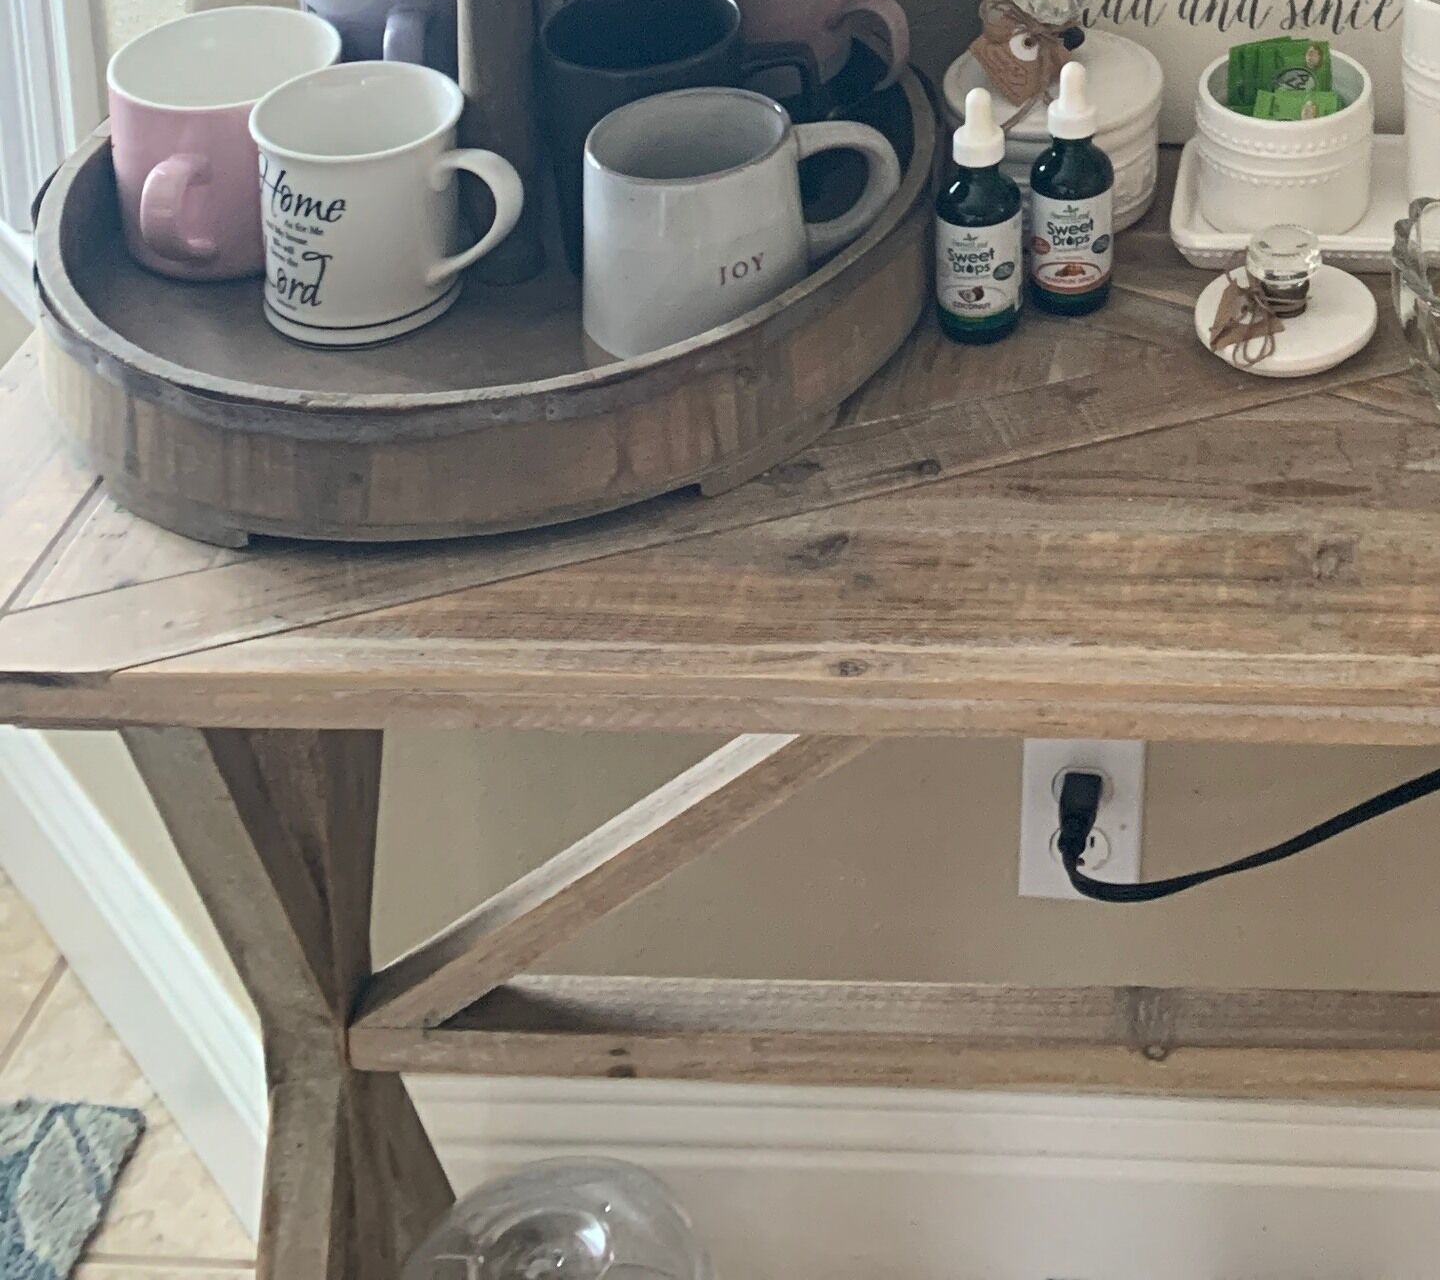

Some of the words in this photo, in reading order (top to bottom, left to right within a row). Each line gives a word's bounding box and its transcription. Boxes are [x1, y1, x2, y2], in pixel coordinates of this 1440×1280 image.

[260, 158, 347, 223] Home
[1047, 218, 1094, 236] Sweet
[1052, 233, 1091, 247] Drops
[947, 247, 995, 264] Sweet
[720, 251, 765, 286] JOY
[952, 262, 991, 276] Drops
